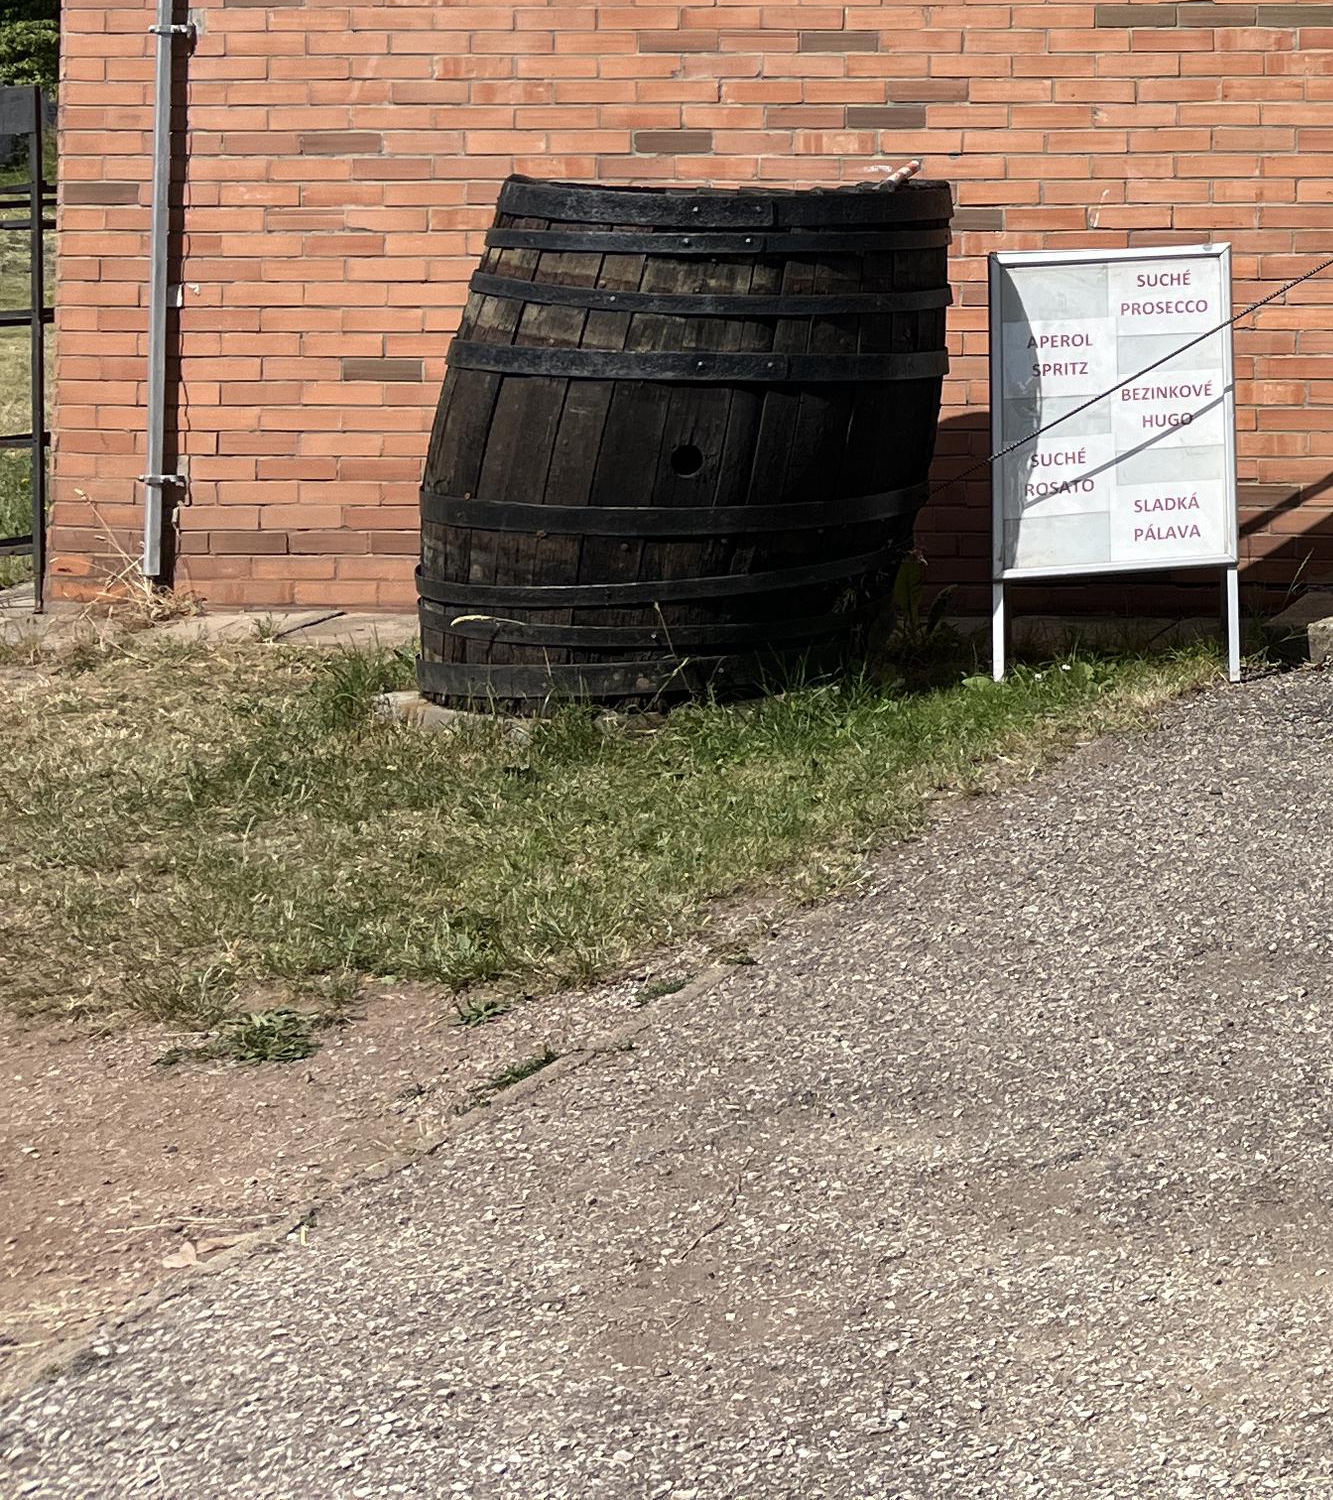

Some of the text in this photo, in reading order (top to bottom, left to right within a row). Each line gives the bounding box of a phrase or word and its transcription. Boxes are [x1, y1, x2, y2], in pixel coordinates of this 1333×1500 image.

[1136, 269, 1192, 288] SUCHÉ
[1120, 299, 1208, 316] PROSECCO
[1026, 333, 1093, 349] APEROL
[1031, 362, 1089, 377] SPRITZ
[1121, 380, 1214, 402] BEZINKOVÉ
[1142, 412, 1194, 429] HUGO
[1030, 447, 1087, 468] SUCHÉ
[1024, 477, 1095, 497] ROSATO
[1134, 492, 1200, 513] SLADKÁ
[1134, 524, 1201, 542] PÁLAVA
